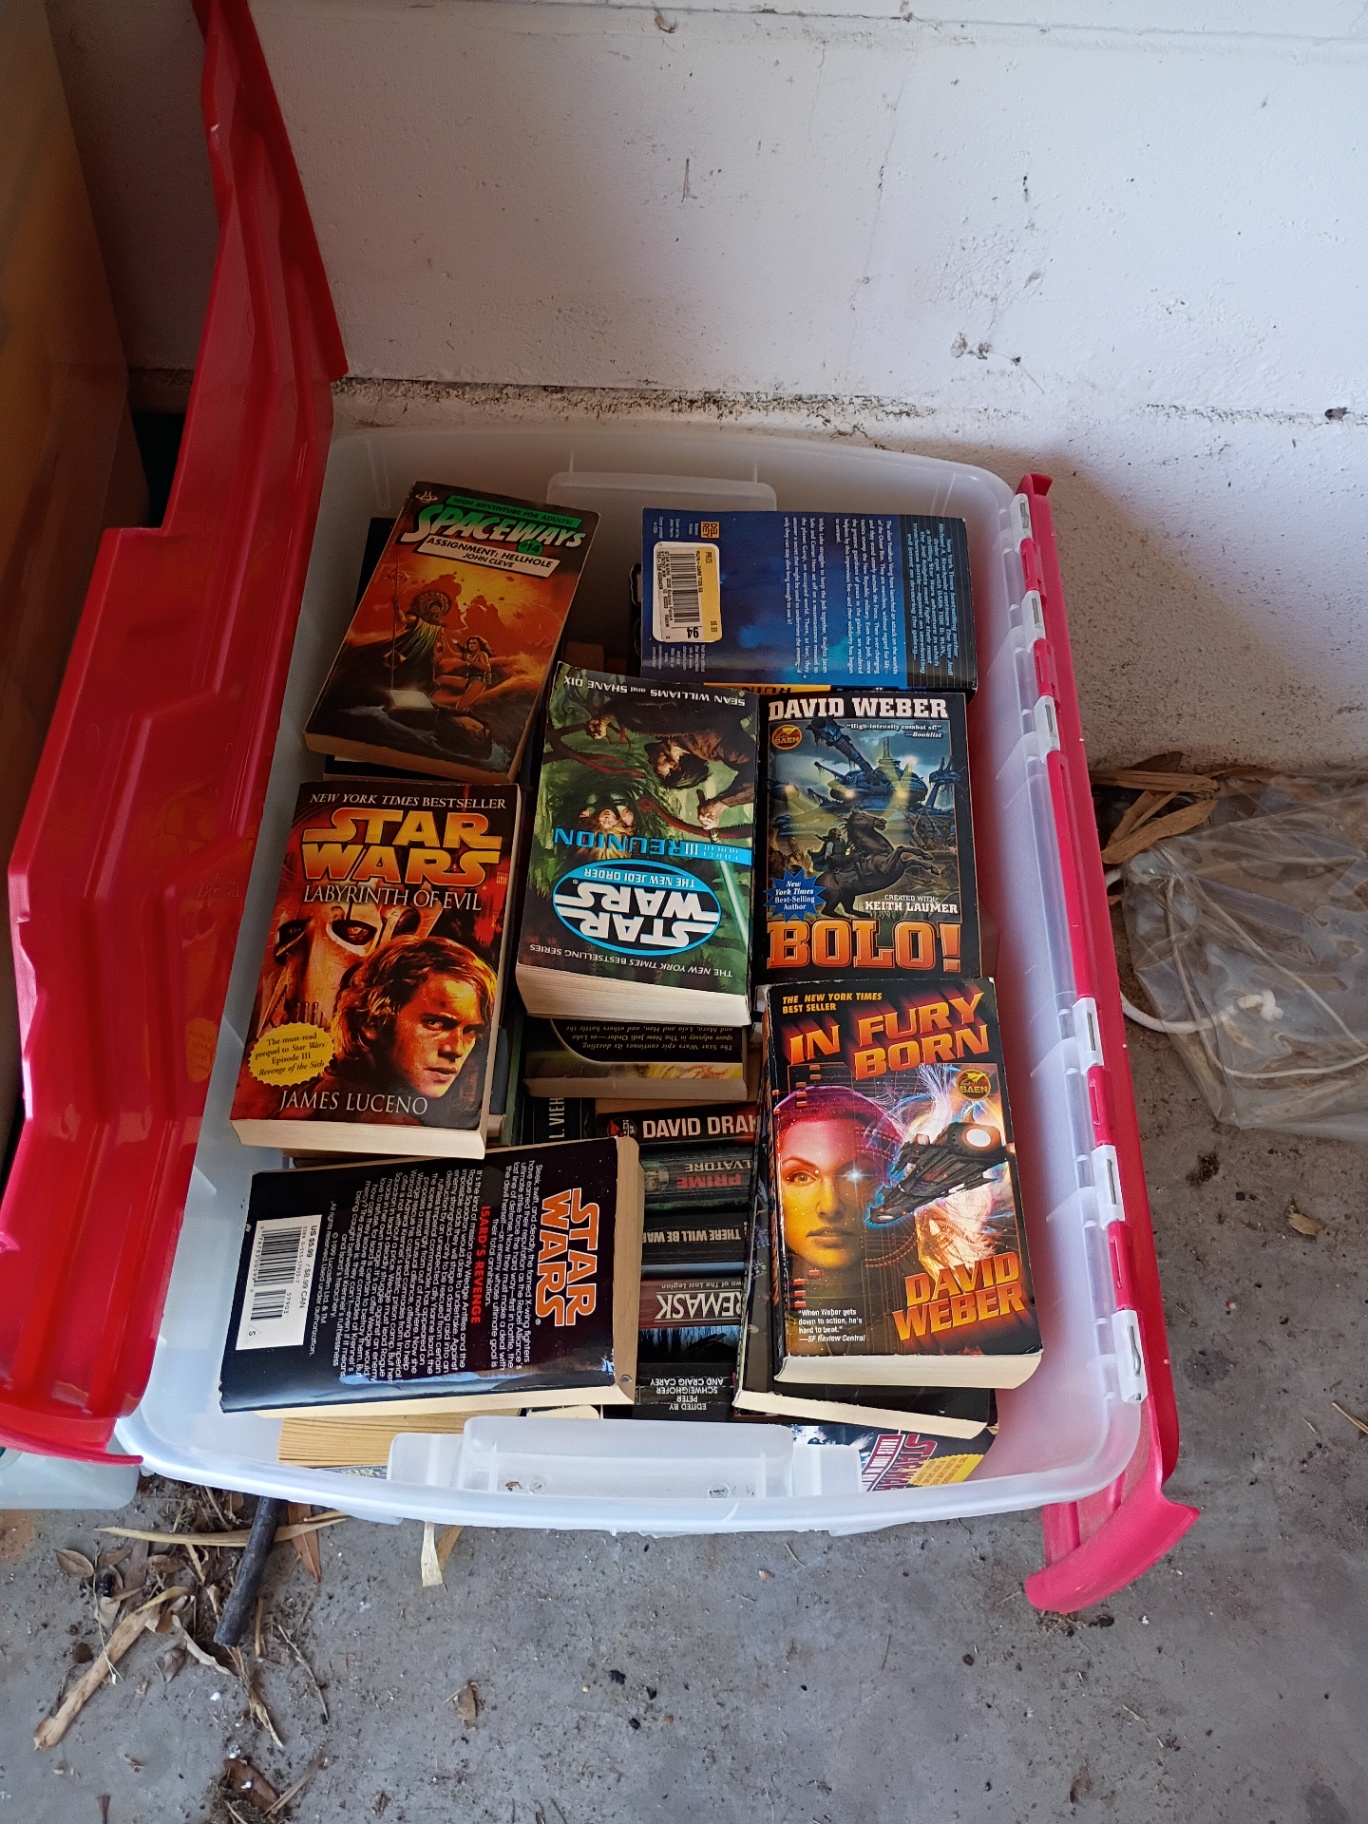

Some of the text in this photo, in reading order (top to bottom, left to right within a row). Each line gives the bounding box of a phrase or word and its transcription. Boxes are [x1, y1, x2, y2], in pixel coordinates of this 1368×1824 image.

[477, 501, 521, 515] ADVENTURE
[523, 510, 539, 519] FOR
[401, 505, 586, 548] SPACEWAYS
[426, 537, 553, 568] ASSIGNMENT: HELLHOLE
[463, 553, 514, 568] JOHN CLEVE
[687, 627, 699, 639] 94
[564, 676, 583, 687] DIX
[587, 680, 628, 693] SHANE
[649, 689, 709, 702] WILLIAMS
[713, 695, 746, 706] SEAN
[768, 697, 949, 721] DAVID WEBER
[901, 723, 927, 731] combat
[775, 736, 801, 744] BAEN
[309, 793, 507, 809] NEW YORK TIMES BESTSELLER
[302, 807, 503, 850] STAR
[553, 827, 683, 858] REUNION
[301, 843, 501, 888] WARS
[584, 868, 695, 888] THE NEW JEDI ORDER
[786, 880, 801, 888] New
[303, 885, 482, 911] LABYRINTH OF EVIL
[774, 896, 815, 904] Best-Selling
[775, 887, 814, 896] York Times
[884, 894, 915, 902] CREATED
[554, 881, 718, 922] WARS
[783, 902, 806, 911] Author
[864, 901, 959, 914] KEITH LAUMER
[555, 906, 716, 948] STAR
[766, 919, 962, 974] BOLO!
[529, 943, 732, 978] THE NEW YORK TIMES BESTSELLING SERIES
[782, 992, 882, 1004] THE NEW YORK TIMES
[782, 1002, 836, 1014] BEST SELLER
[789, 992, 984, 1065] IN FURY
[267, 1032, 317, 1047] The must-read
[582, 1042, 611, 1050] dazzling
[255, 1046, 280, 1060] prequel
[292, 1043, 306, 1052] Star
[309, 1041, 326, 1049] Wars
[272, 1052, 311, 1065] Episode III
[854, 1024, 990, 1081] BORN
[259, 1060, 325, 1077] Revenge of the Sith
[960, 1086, 988, 1094] BAEN
[279, 1090, 428, 1115] JAMES LUCENO
[548, 1097, 565, 1139] L. VIEH
[643, 1118, 701, 1139] DAVID
[684, 1159, 751, 1172] LVATORE
[533, 1164, 543, 1186] Sleek,
[676, 1174, 741, 1189] PRIME
[531, 1187, 541, 1204] swift,
[310, 1225, 317, 1237] US
[527, 1224, 537, 1253] deadly,
[666, 1231, 680, 1242] BE
[681, 1229, 707, 1242] WILL
[708, 1228, 741, 1241] THERE
[306, 1238, 315, 1258] $5.99
[470, 1206, 491, 1324] ISARD'S REVENGE
[515, 1160, 535, 1370] have earned their reputation as the Rebel Alliance's
[527, 1254, 535, 1268] the
[535, 1188, 572, 1327] WARS
[565, 1188, 600, 1326] STAR
[301, 1269, 311, 1289] $8.99
[525, 1269, 533, 1297] famed
[661, 1282, 686, 1290] Legion
[904, 1251, 1019, 1307] DAVID
[299, 1290, 308, 1309] CAN
[654, 1291, 742, 1319] REMASK
[522, 1299, 532, 1328] X-wing
[821, 1309, 841, 1317] Weber
[891, 1281, 1026, 1342] WEBER
[522, 1330, 531, 1362] fighters
[650, 1378, 723, 1386] AND CRAIG CAREY
[656, 1386, 718, 1394] SCHWEIGHOFER
[676, 1395, 698, 1403] PETER
